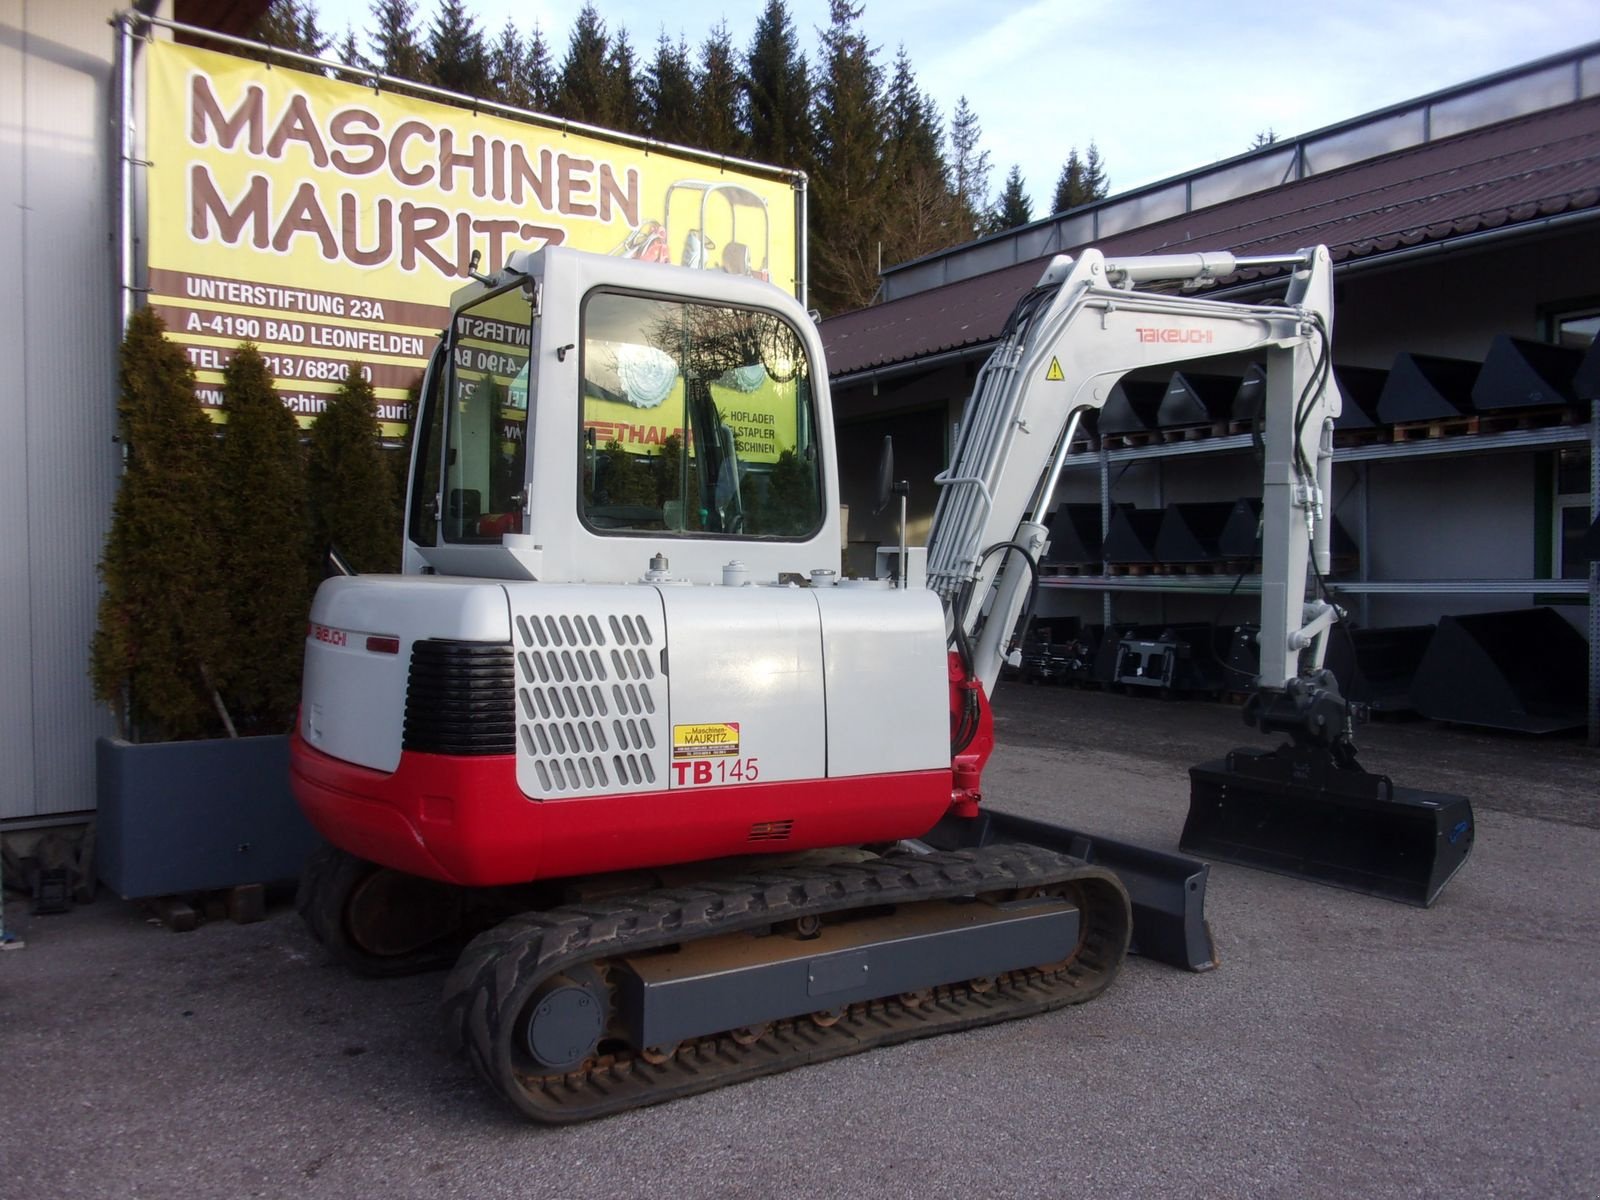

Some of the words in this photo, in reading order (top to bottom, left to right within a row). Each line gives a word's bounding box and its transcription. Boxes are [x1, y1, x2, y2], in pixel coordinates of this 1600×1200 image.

[192, 74, 639, 227] MASCHINEN
[187, 277, 345, 316] UNTERSTIFTUNG
[350, 299, 384, 320] 23A
[187, 312, 260, 338] A-4190
[265, 321, 305, 343] BAD
[311, 326, 424, 356] LEONFELDEN
[187, 347, 230, 370] TEL:
[730, 411, 775, 425] HOFLADER
[684, 733, 727, 744] MAURITZ
